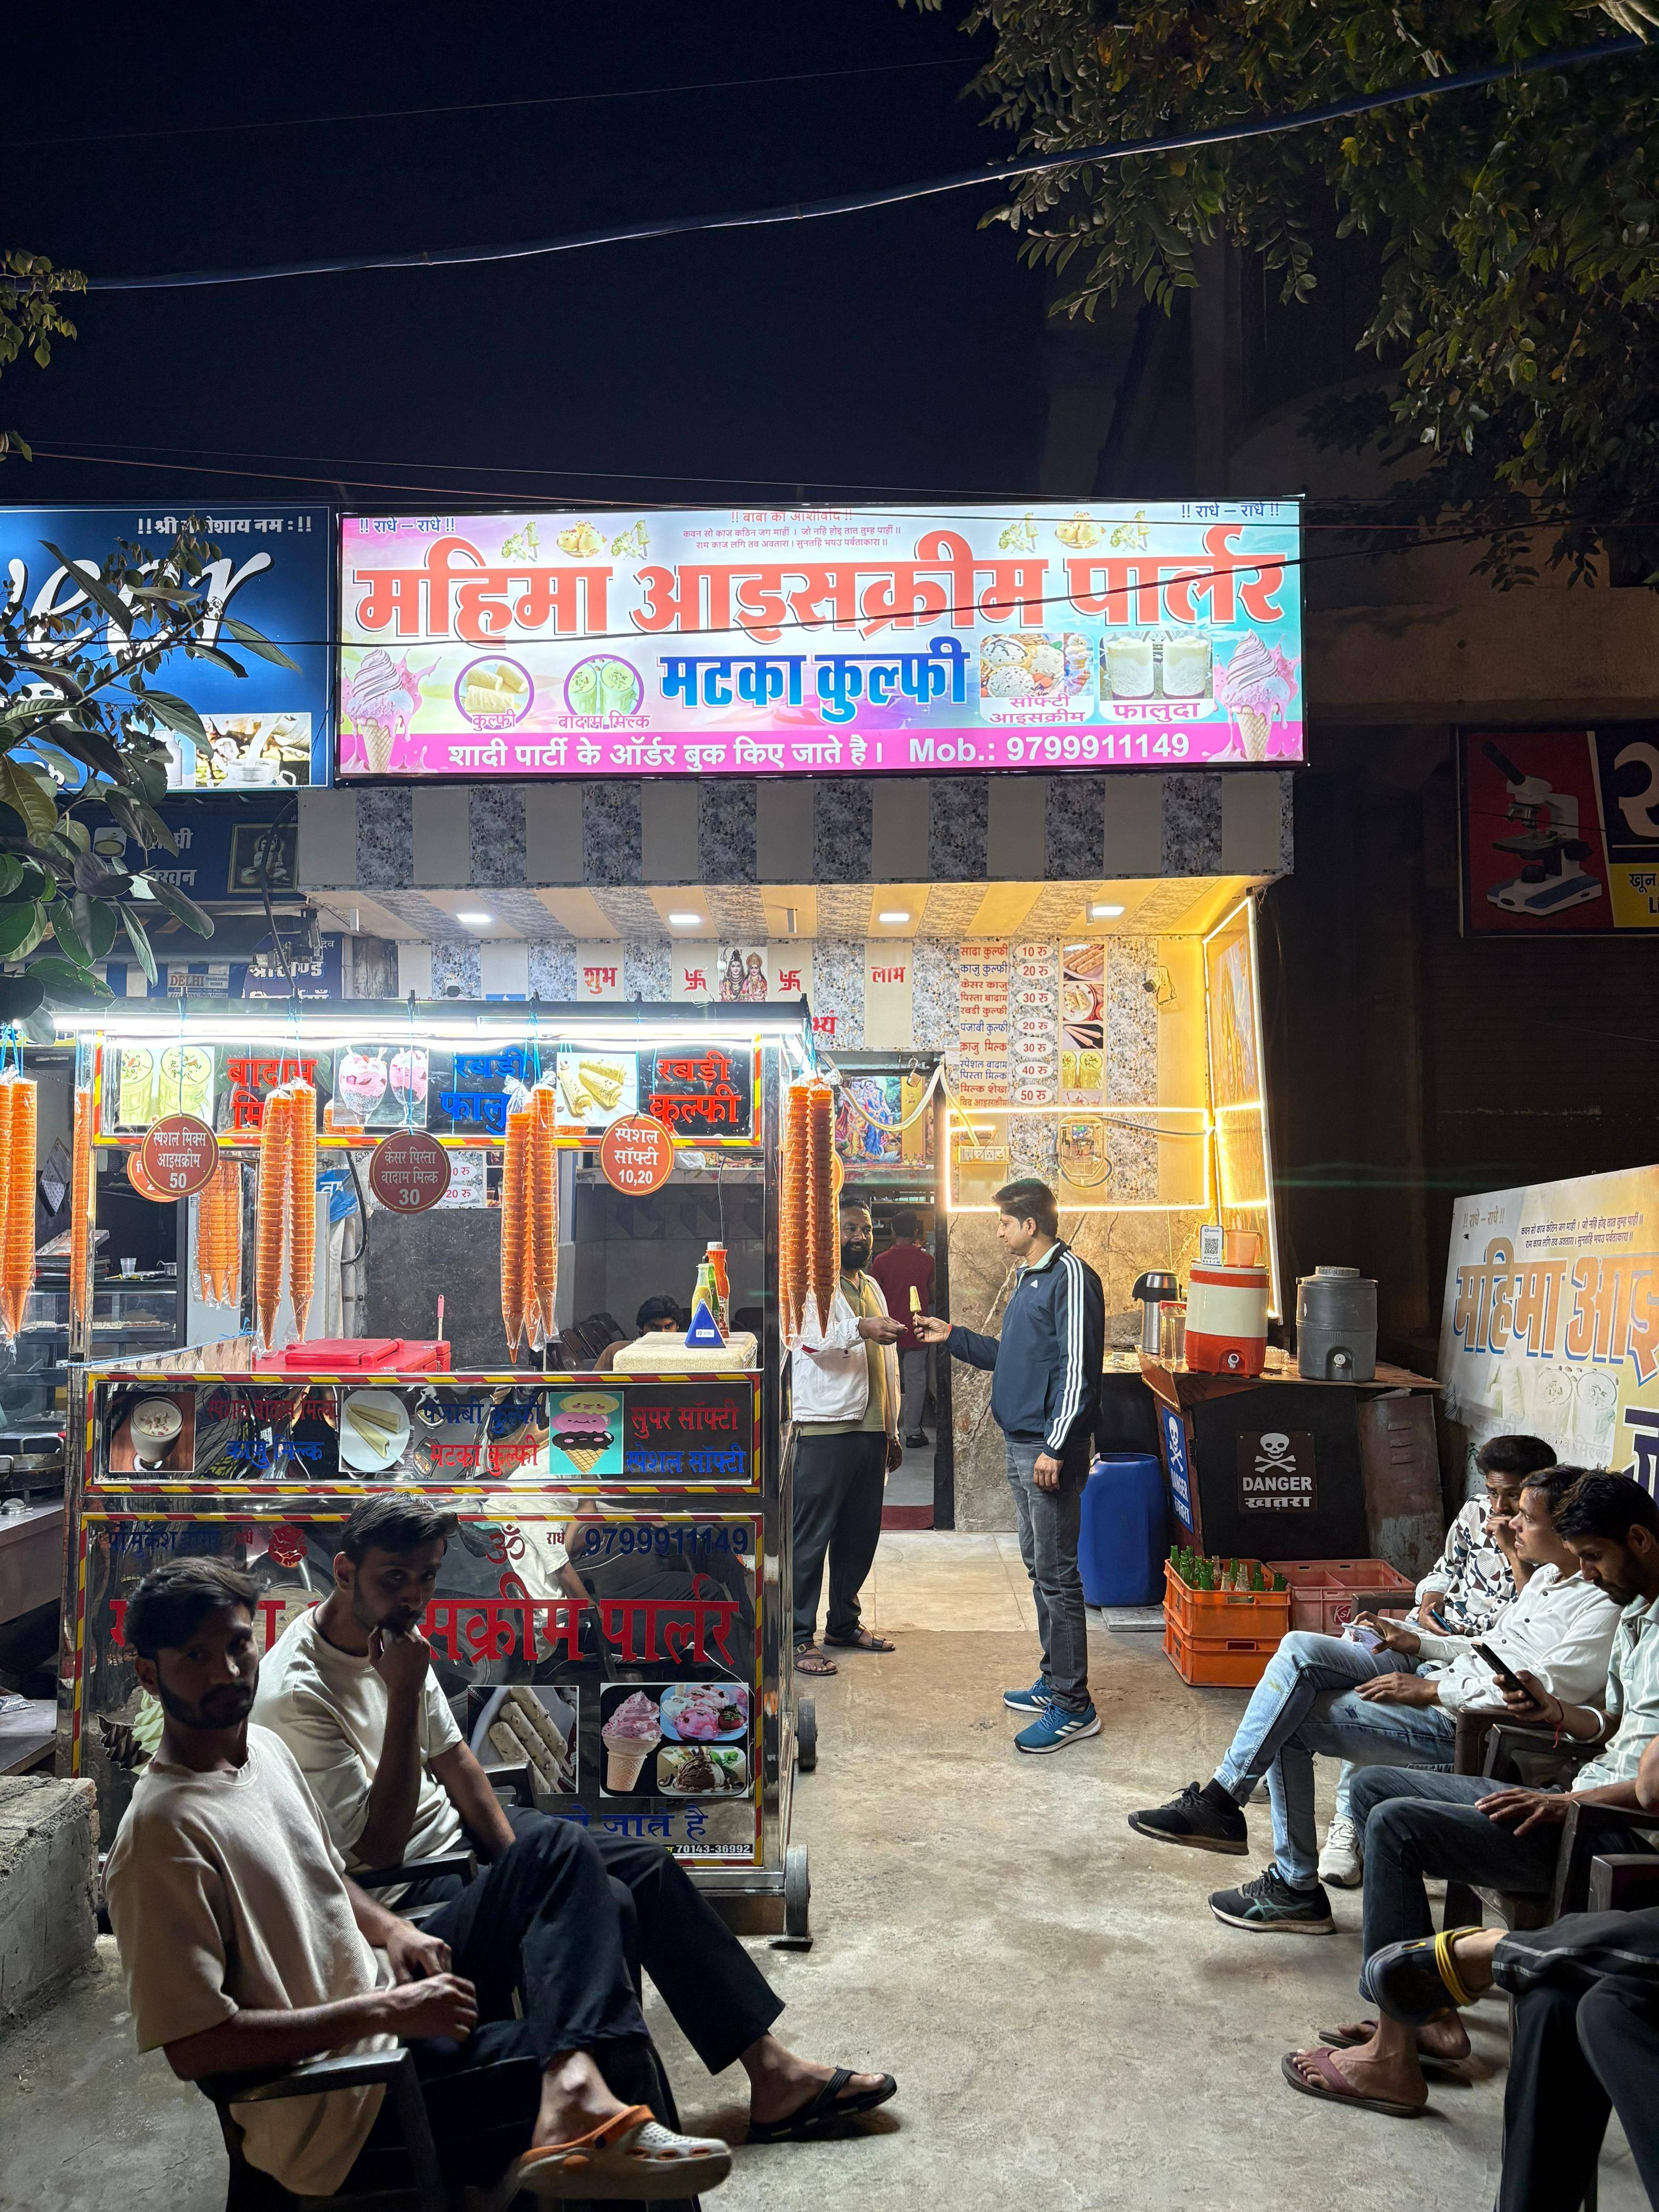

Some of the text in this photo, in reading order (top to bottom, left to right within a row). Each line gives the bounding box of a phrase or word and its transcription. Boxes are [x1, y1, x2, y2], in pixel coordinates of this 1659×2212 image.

[743, 513, 767, 523] बाबा
[771, 512, 786, 522] का
[1195, 501, 1265, 518] राधे राधे
[154, 516, 178, 534] श्री
[373, 514, 441, 533] राधे राधे
[705, 528, 713, 538] सो
[735, 527, 756, 537] कठिन
[801, 526, 811, 535] जो
[814, 525, 827, 535] नहिं
[830, 525, 842, 535] होइ
[860, 527, 875, 536] तुम्ह
[731, 539, 745, 548] लगि
[844, 537, 881, 546] पर्वताकारा
[354, 524, 1287, 650] महिमा आइसक्रीम पार्लर
[657, 636, 970, 725] मटका कुल्फी
[472, 709, 516, 731] कुल्फी
[558, 710, 651, 730] बादाम मिल्क
[989, 708, 1086, 725] आइसक्रीम
[1113, 702, 1200, 722] फालुदा
[449, 732, 1191, 772] शादी पार्टी के ऑर्डर बुक किए जाते है Mob.: 9799911149
[1629, 873, 1657, 893] खून
[960, 943, 1008, 959] सादा कुल्फी
[1023, 946, 1048, 957] 10 रु
[870, 966, 906, 984] लाभ
[960, 961, 1008, 976] काजु कुल्फी
[1023, 966, 1049, 976] 20 रु
[170, 975, 204, 986] DELHI
[583, 966, 618, 994] शुभ
[960, 978, 984, 988] केसर
[960, 992, 983, 1002] पिस्ता
[1023, 993, 1049, 1003] 30 रु
[983, 1005, 1008, 1017] कुल्फी
[960, 1019, 1008, 1036] पंजाबी कुल्फी
[1023, 1021, 1035, 1030] 20
[960, 1038, 1007, 1055] काजु मिल्क
[1023, 1043, 1046, 1052] 30 रु
[960, 1057, 984, 1068] स्पेशल
[1022, 1066, 1048, 1075] 40 रु
[227, 1058, 319, 1088] बादाम
[960, 1068, 1007, 1079] पिस्ता मिल्क
[960, 1082, 985, 1092] मिल्क
[1021, 1090, 1046, 1101] 50 रु
[649, 1083, 742, 1137] कुल्फी
[153, 1126, 207, 1147] स्पेशल मिक्स
[615, 1122, 660, 1144] स्पेशल
[157, 1147, 201, 1170] आइसक्रीम
[384, 1146, 436, 1164] केसर पिस्ता
[614, 1146, 660, 1166] सॉफ्टी
[169, 1172, 187, 1188] 50
[381, 1168, 438, 1186] बादाम मिल्क
[618, 1169, 653, 1186] 10,20
[399, 1188, 420, 1205] 30
[446, 1189, 458, 1198] 20
[1453, 1236, 1569, 1359] महिमा
[631, 1398, 740, 1439] सुपर सॉफ्टी
[430, 1434, 540, 1476] मटका कुल्फी
[625, 1443, 747, 1474] स्पेशल सॉफ्टी
[1170, 1468, 1188, 1503] DANGER
[1243, 1477, 1312, 1492] DANGER
[1172, 1493, 1191, 1524] खतरा
[1244, 1496, 1312, 1509] खतरा
[547, 1528, 566, 1545] राधे
[584, 1527, 748, 1555] 9799911149
[599, 1573, 740, 1665] पार्लर
[601, 1806, 675, 1837] जाते
[684, 1803, 709, 1842] है
[676, 1845, 750, 1854] 70143-36992
